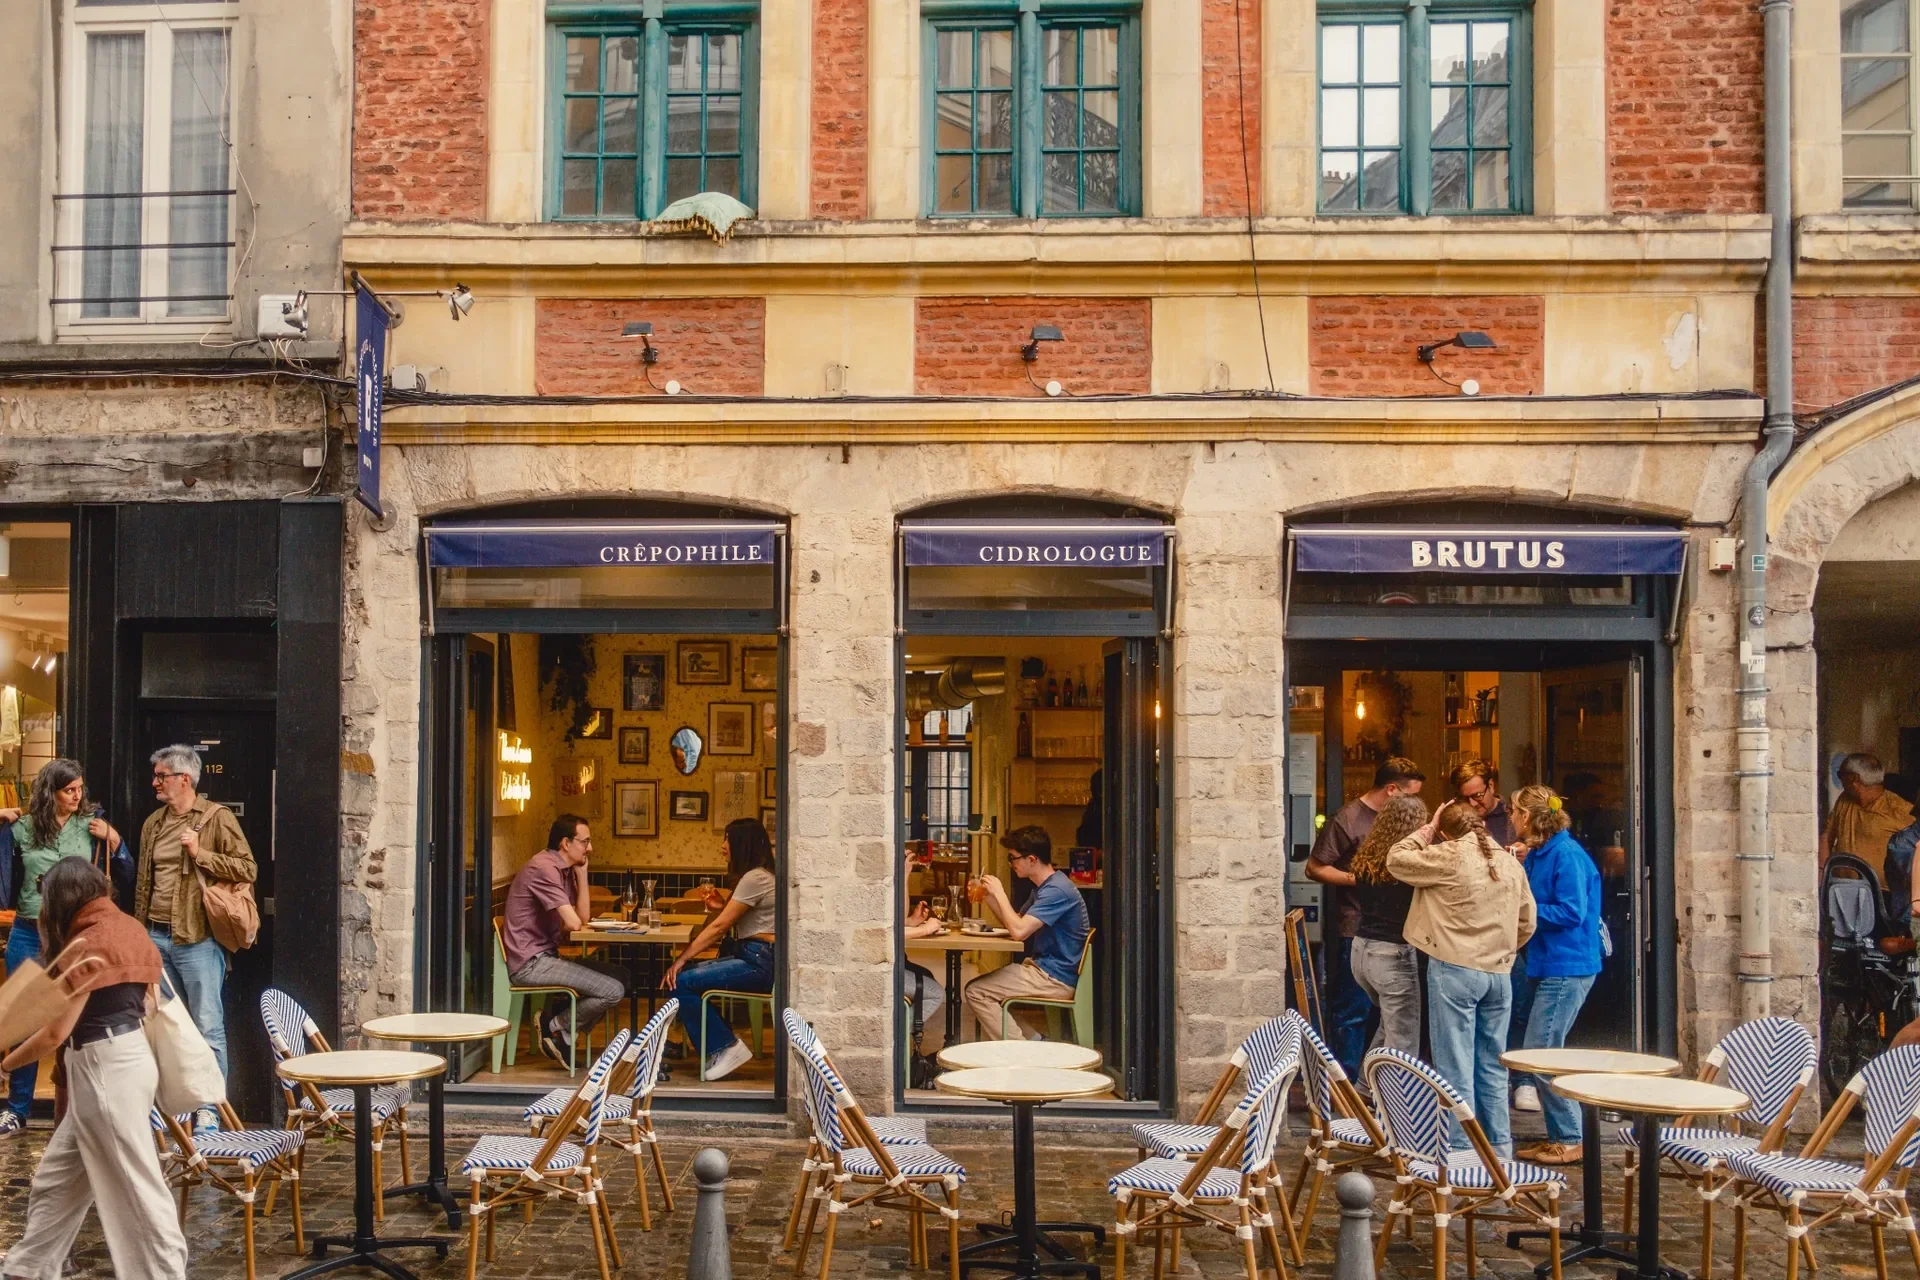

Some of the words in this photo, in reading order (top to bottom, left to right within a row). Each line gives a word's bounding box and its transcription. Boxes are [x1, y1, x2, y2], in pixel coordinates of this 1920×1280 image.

[600, 543, 762, 562] CRÊPOPHILE
[979, 545, 1152, 562] CIDROLOGUE
[1412, 541, 1565, 568] BRUTUS
[205, 764, 223, 774] 112
